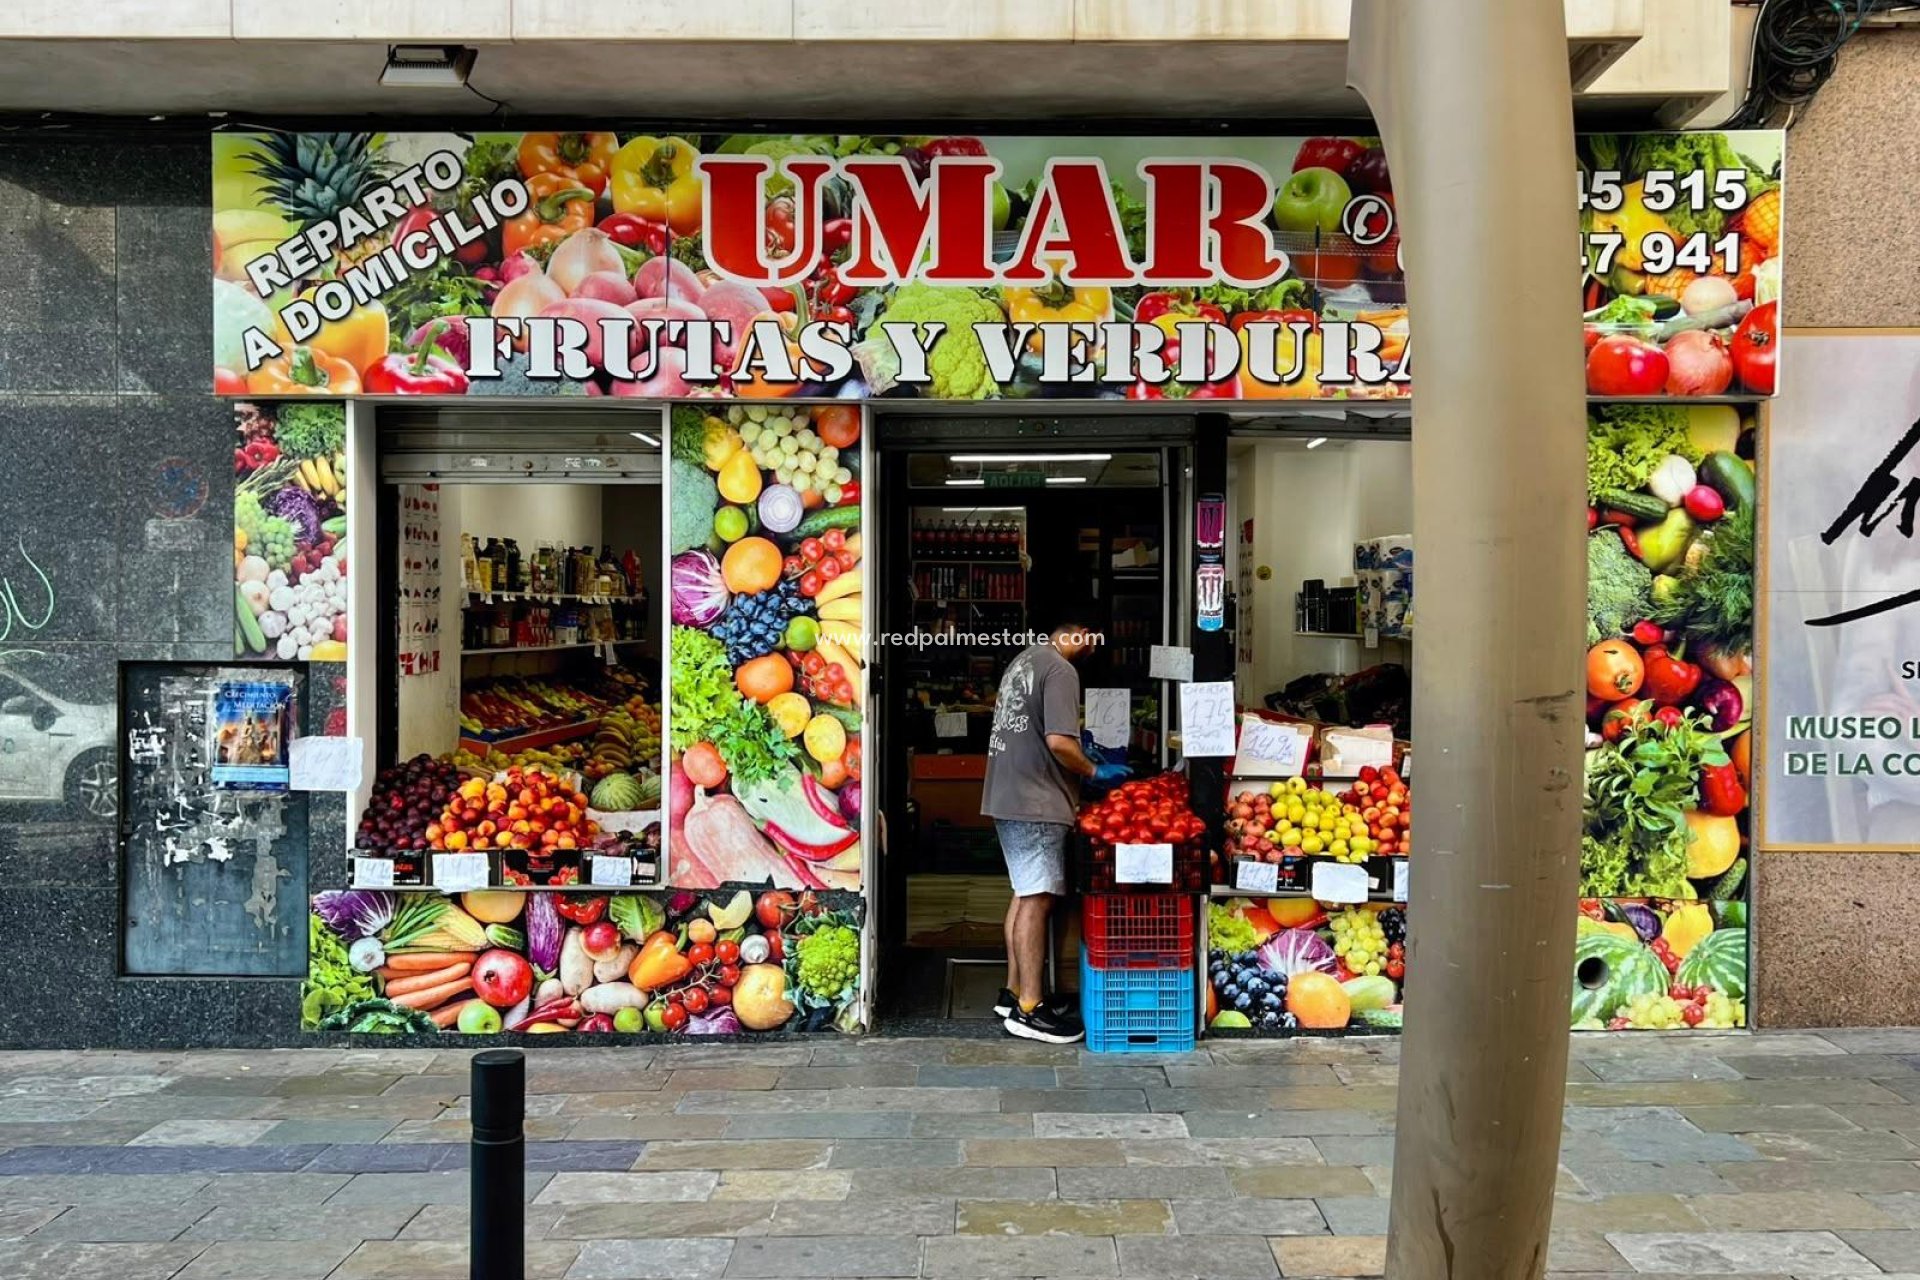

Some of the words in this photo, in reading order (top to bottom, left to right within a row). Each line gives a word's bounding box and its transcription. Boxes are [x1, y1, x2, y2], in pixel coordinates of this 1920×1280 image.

[1642, 169, 1747, 211] 515
[245, 149, 463, 299] REPARTO
[700, 153, 1290, 288] UMAR
[242, 326, 284, 372] A
[279, 178, 530, 344] DOMICILIO
[1579, 231, 1624, 274] 7
[1640, 231, 1740, 274] 941
[464, 316, 854, 382] FRUTAS
[881, 320, 939, 384] Y
[1787, 716, 1902, 740] MUSEO
[1786, 753, 1828, 776] DE
[1837, 753, 1874, 776] LA
